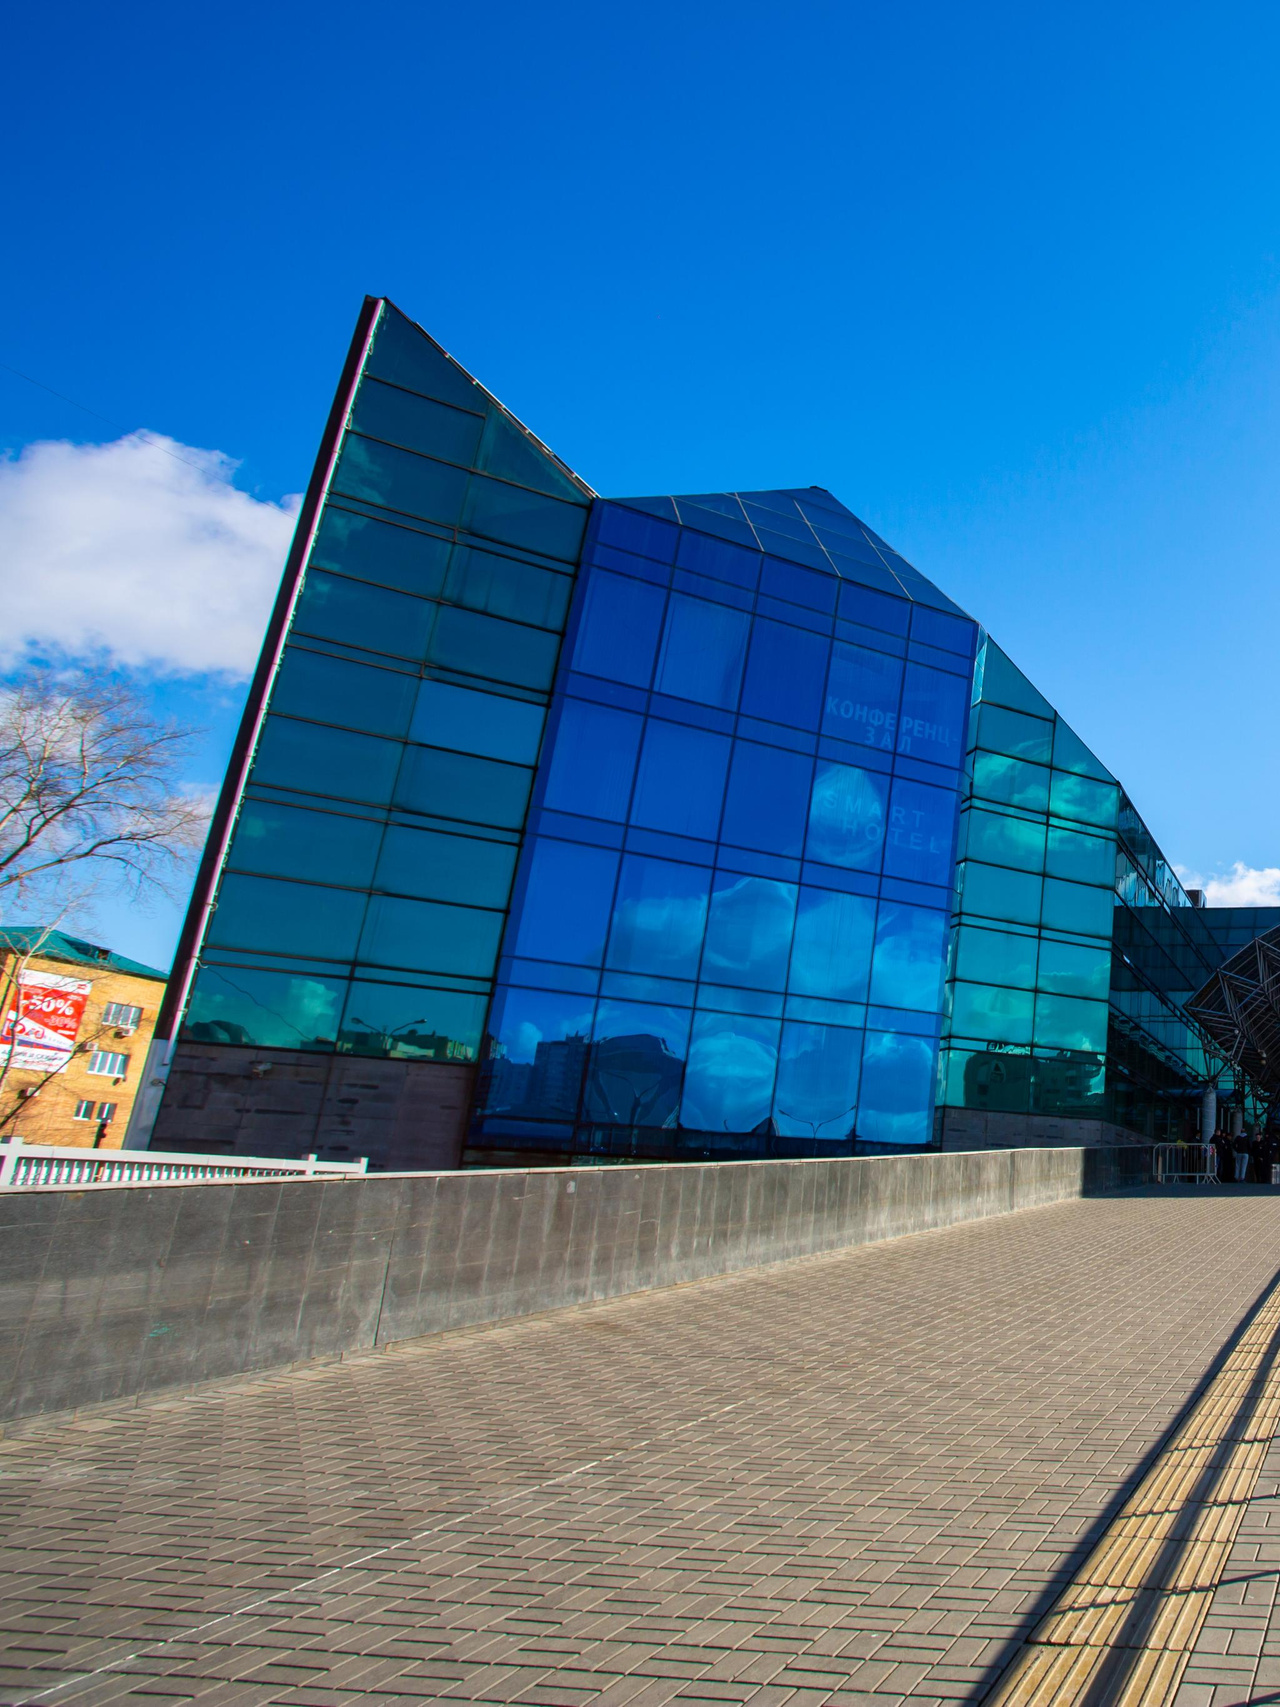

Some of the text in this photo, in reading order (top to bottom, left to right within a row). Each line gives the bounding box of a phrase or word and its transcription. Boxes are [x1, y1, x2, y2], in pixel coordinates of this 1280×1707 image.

[828, 696, 960, 746] КОНФЕРЕНЦ-
[865, 726, 911, 753] ЗАЛ
[825, 791, 924, 828] SMART
[842, 822, 940, 854] HOTEL
